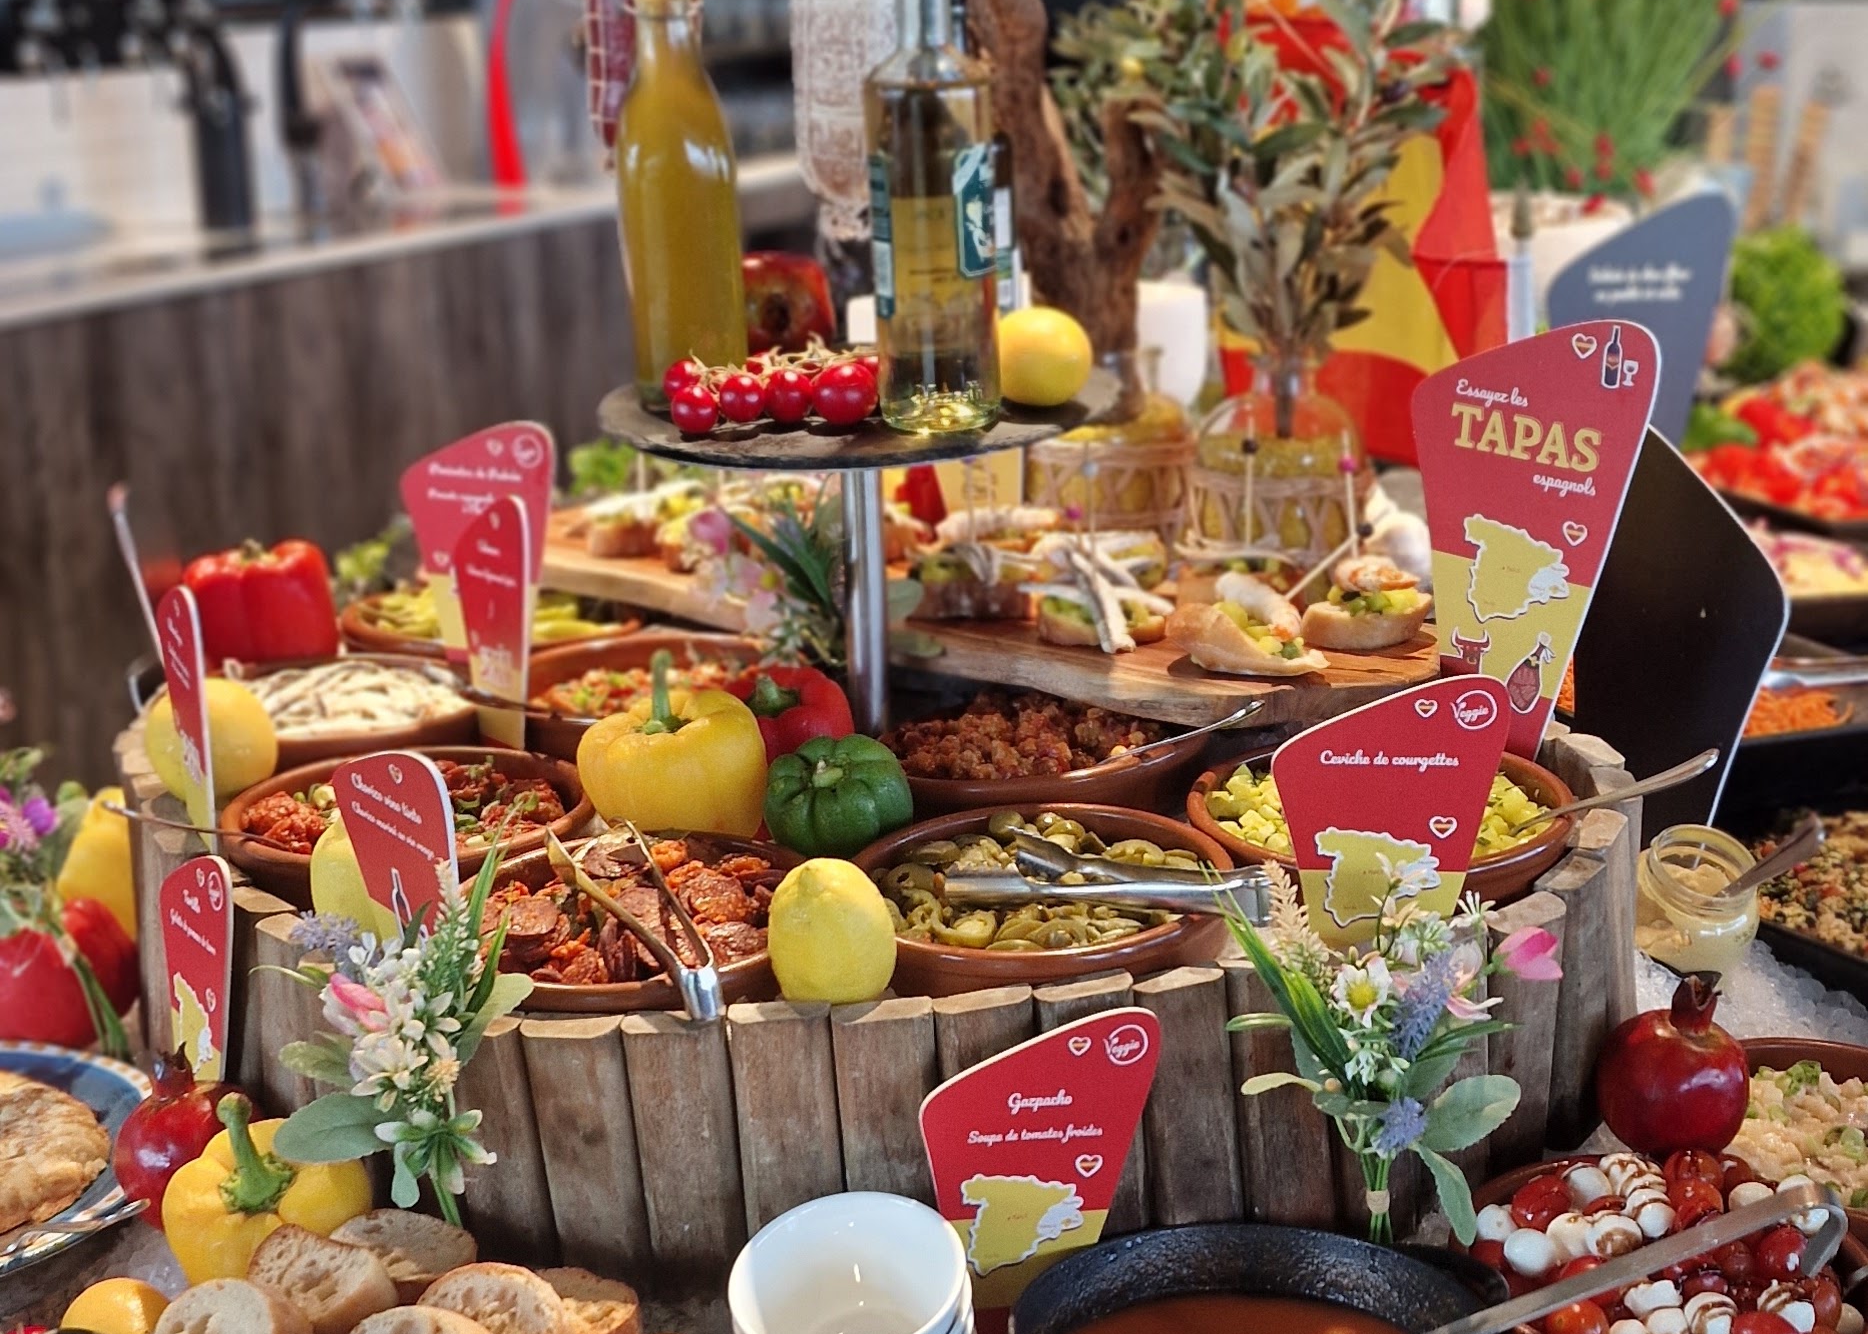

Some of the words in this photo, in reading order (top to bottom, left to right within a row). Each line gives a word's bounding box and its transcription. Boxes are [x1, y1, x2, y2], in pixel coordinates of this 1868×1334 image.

[1456, 378, 1509, 407] Essayez
[1510, 387, 1529, 407] les
[1451, 401, 1602, 472] TAPAS
[1533, 474, 1596, 497] espagnols
[1449, 701, 1489, 723] Veggie
[1373, 750, 1390, 765] de
[1391, 752, 1459, 772] courgettes
[1102, 1037, 1140, 1058] Veggie
[1008, 1088, 1073, 1115] Gazpacho
[967, 1130, 1003, 1147] Soupe
[1005, 1128, 1019, 1142] de
[1020, 1126, 1063, 1141] tomates
[1061, 1123, 1103, 1144] froides
